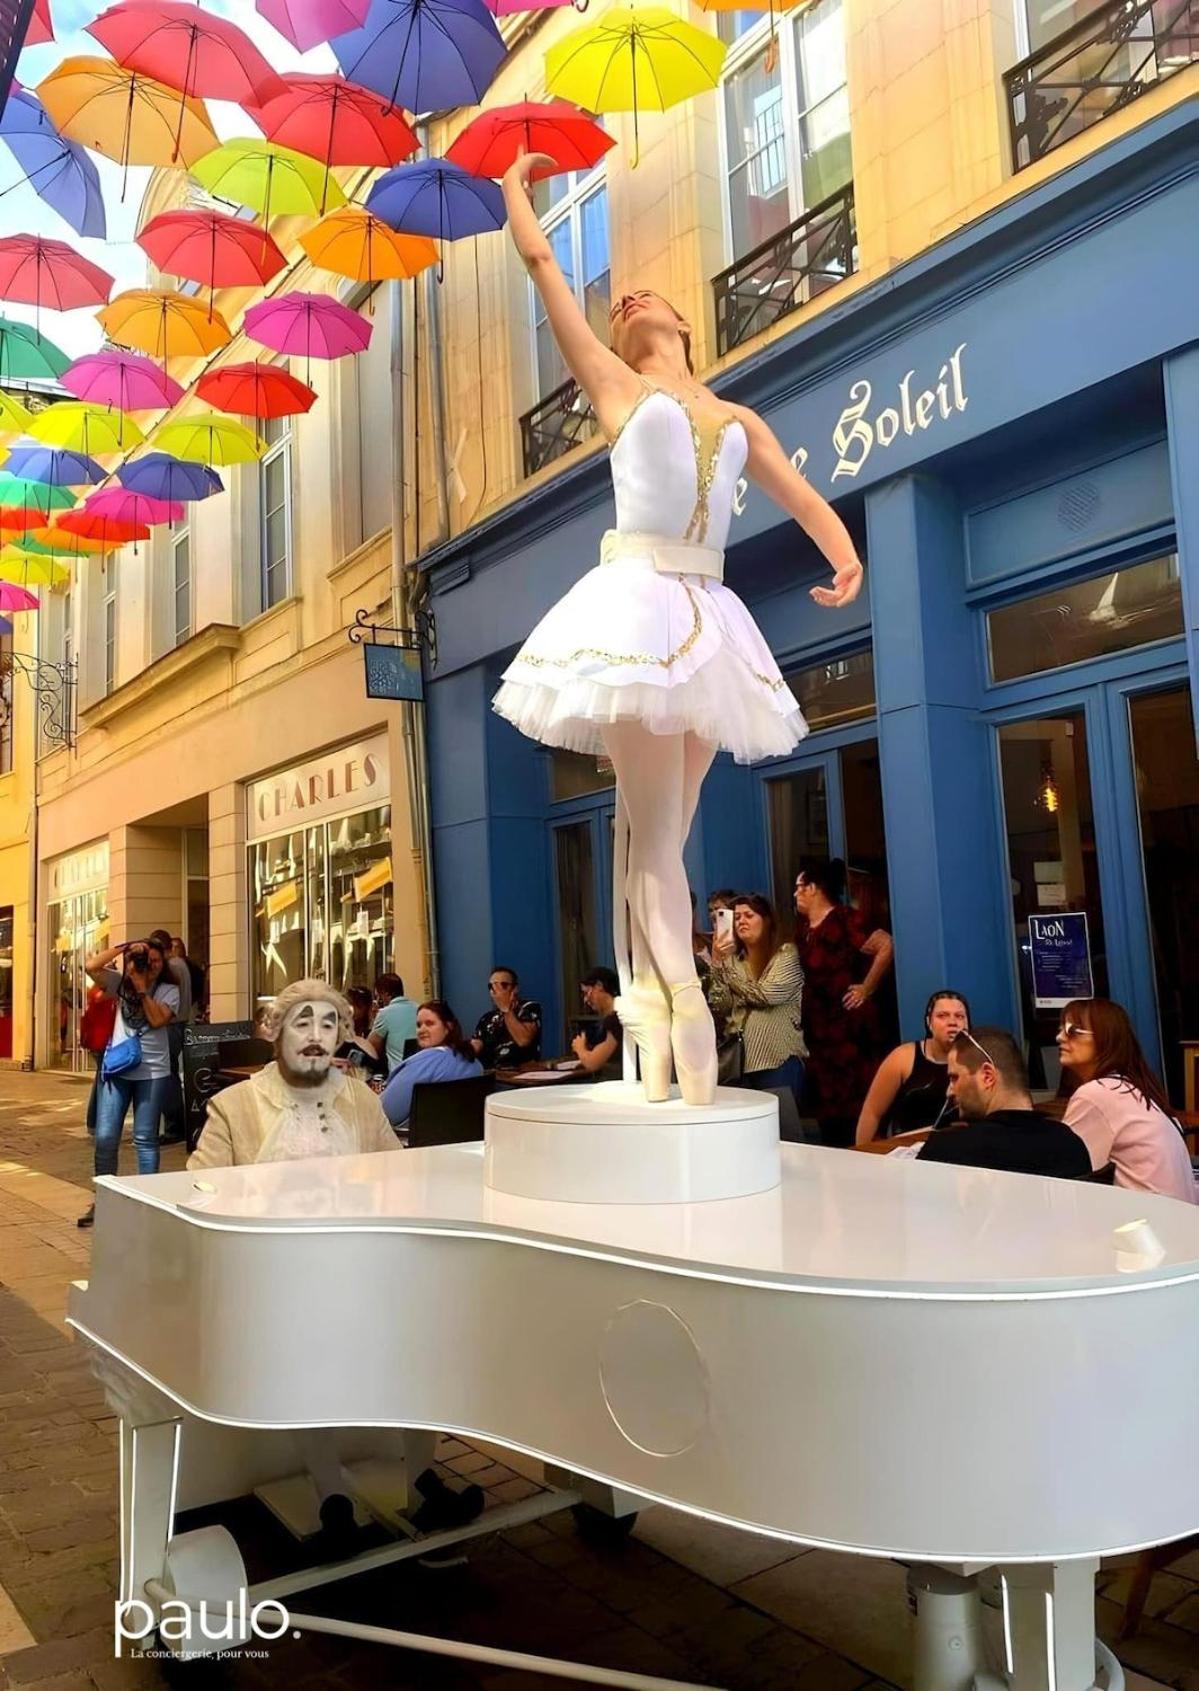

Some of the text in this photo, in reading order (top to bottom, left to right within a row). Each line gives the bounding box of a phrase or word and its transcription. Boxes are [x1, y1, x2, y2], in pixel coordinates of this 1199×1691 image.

[830, 342, 968, 483] Soleil
[258, 752, 380, 821] CHARLES
[1034, 919, 1065, 940] LAON
